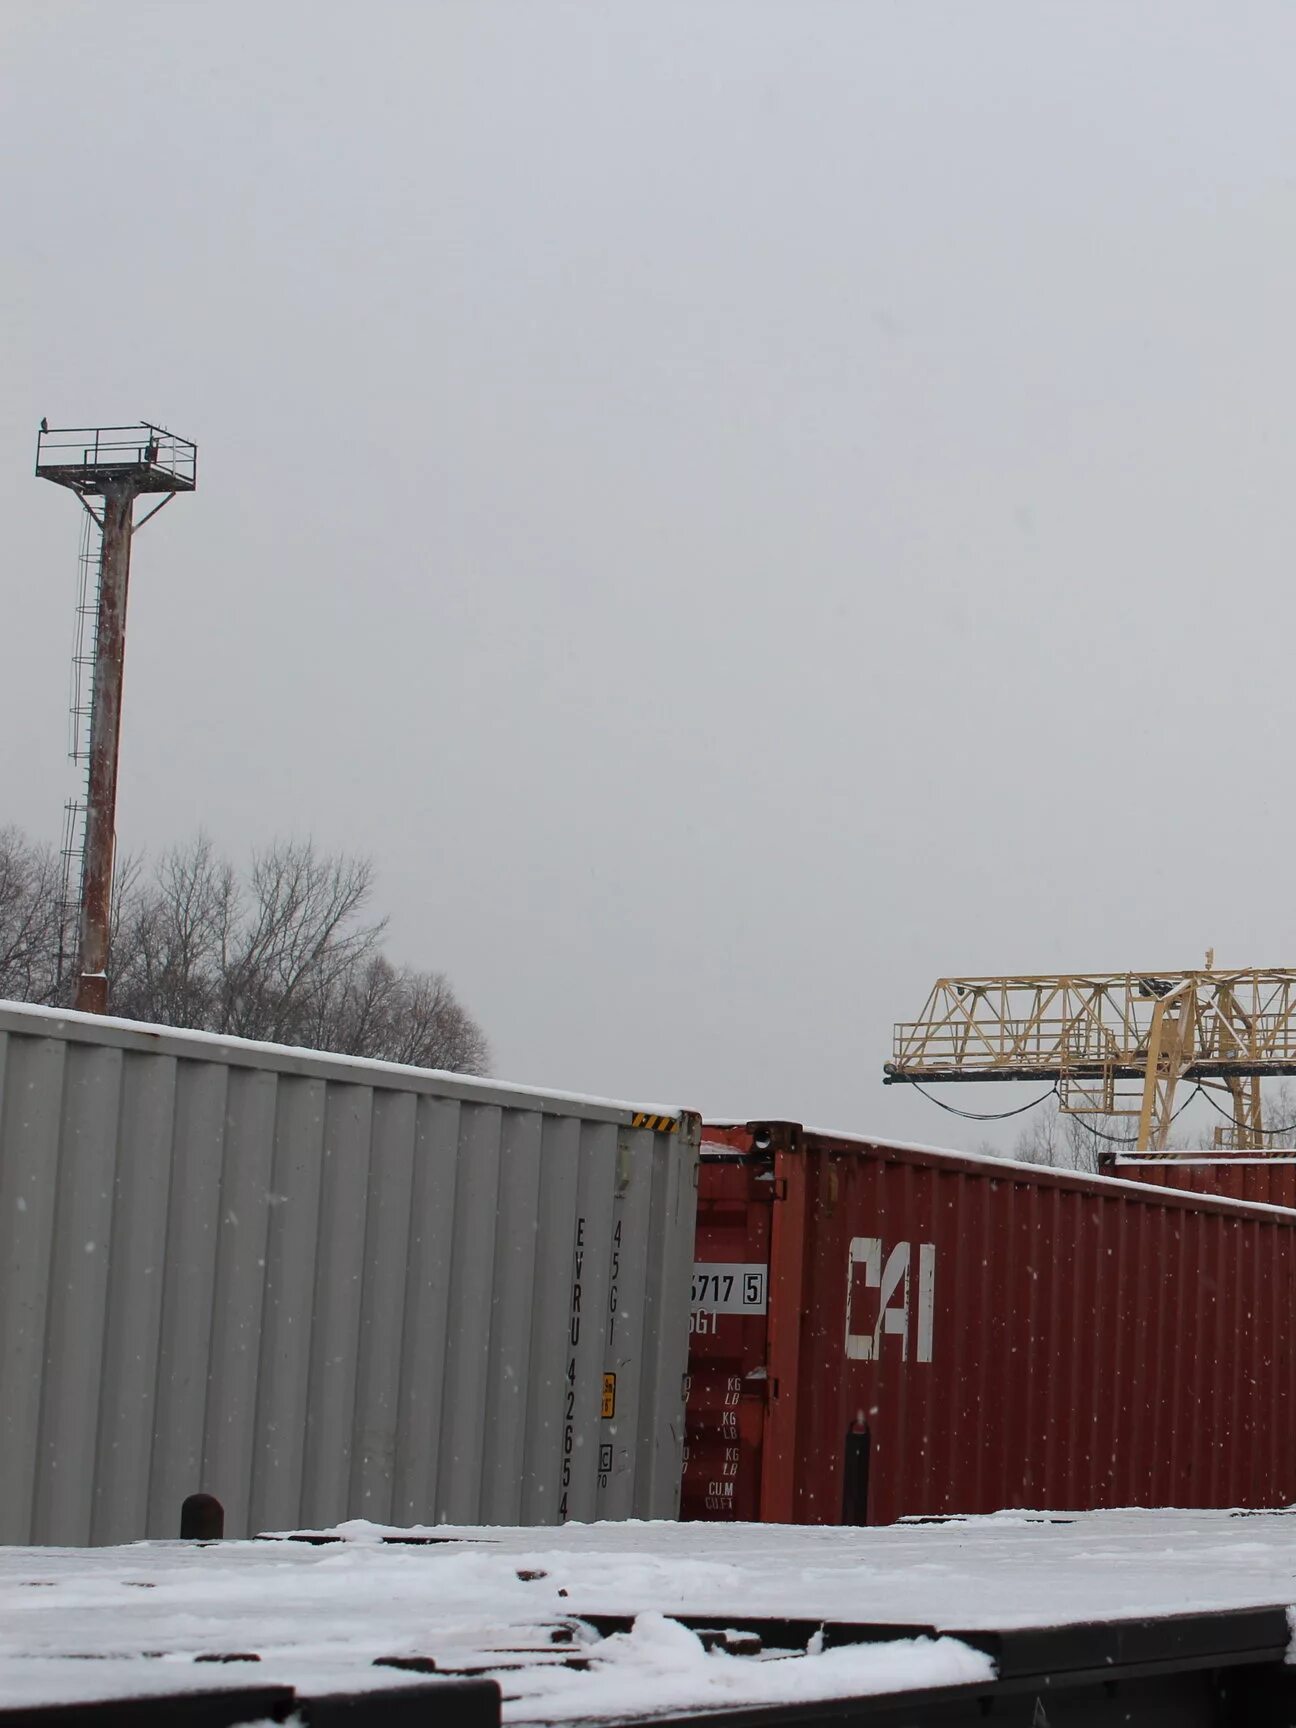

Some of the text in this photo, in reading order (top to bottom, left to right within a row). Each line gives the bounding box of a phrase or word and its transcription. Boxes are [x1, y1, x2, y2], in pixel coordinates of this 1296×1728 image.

[746, 1275, 759, 1303] 5
[727, 1377, 741, 1392] KG
[722, 1411, 736, 1426] KG
[725, 1447, 740, 1461] KG
